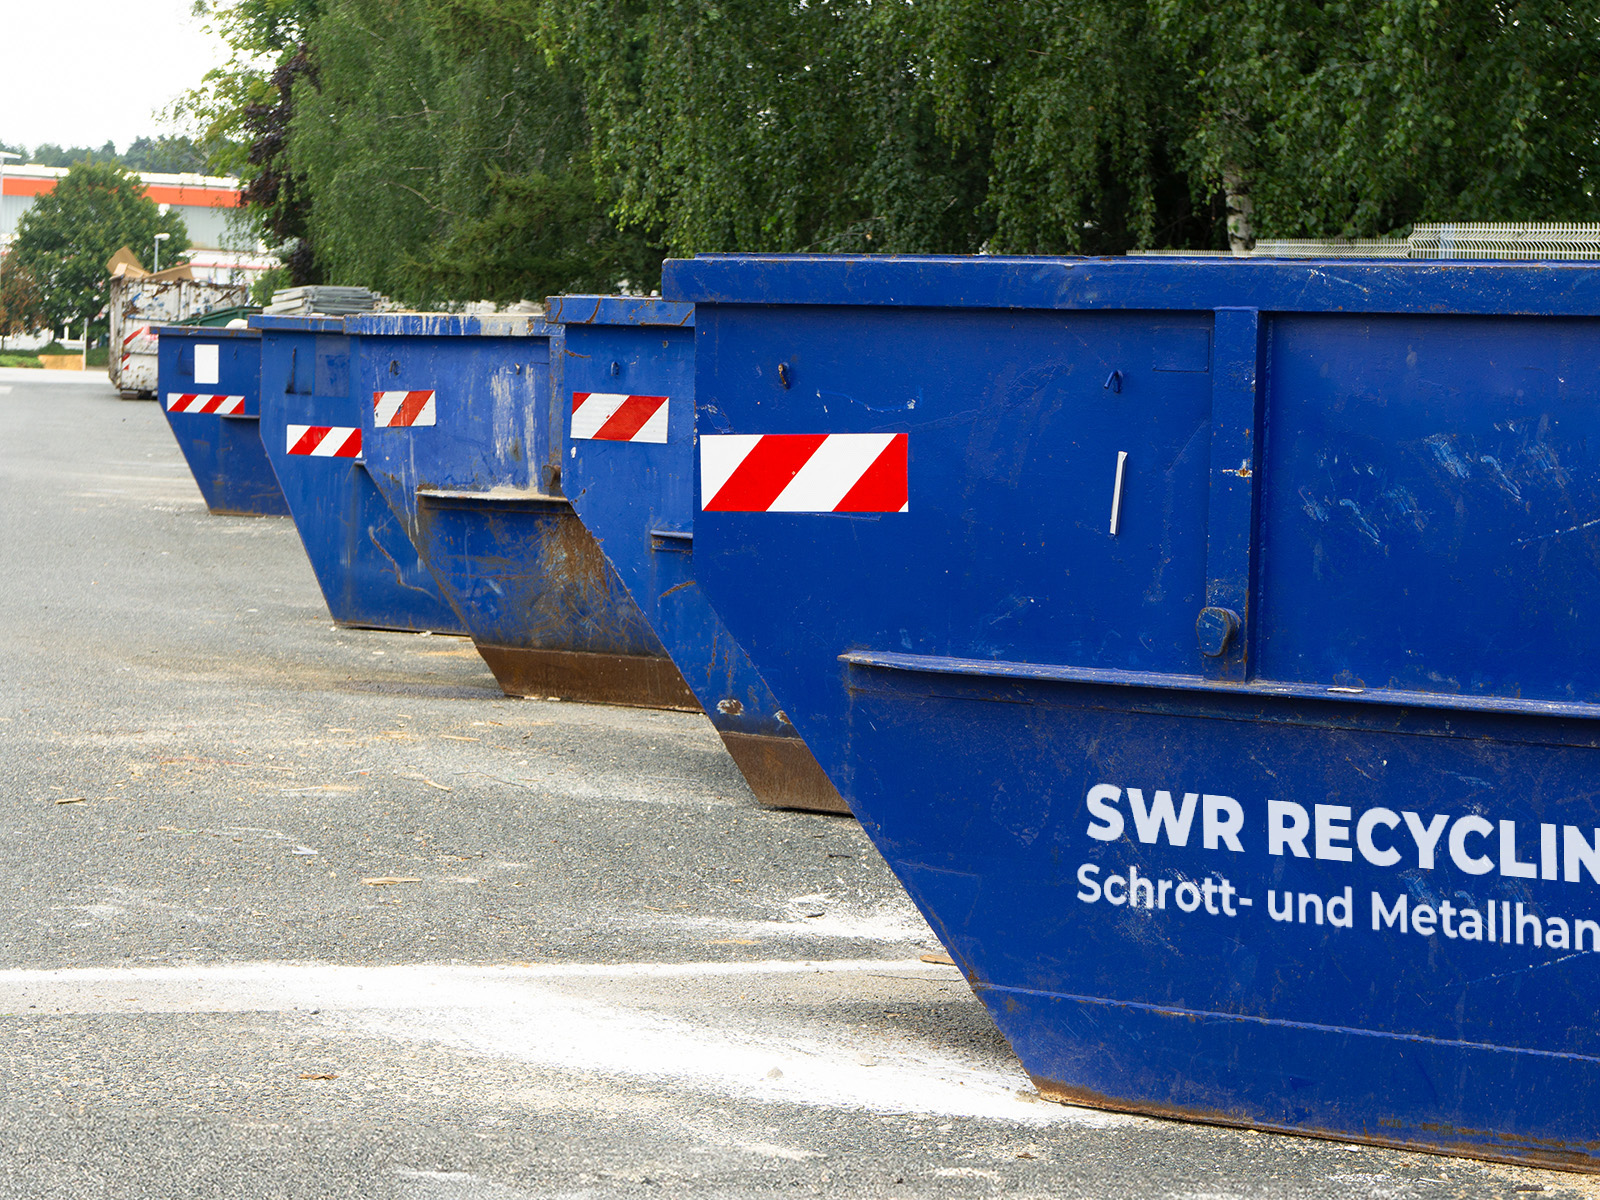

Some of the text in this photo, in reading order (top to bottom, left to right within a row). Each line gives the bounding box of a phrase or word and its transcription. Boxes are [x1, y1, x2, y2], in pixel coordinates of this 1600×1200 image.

[1086, 783, 1600, 885] SWR RECYCLIN
[1077, 863, 1600, 952] Schrott- und Metallhan
